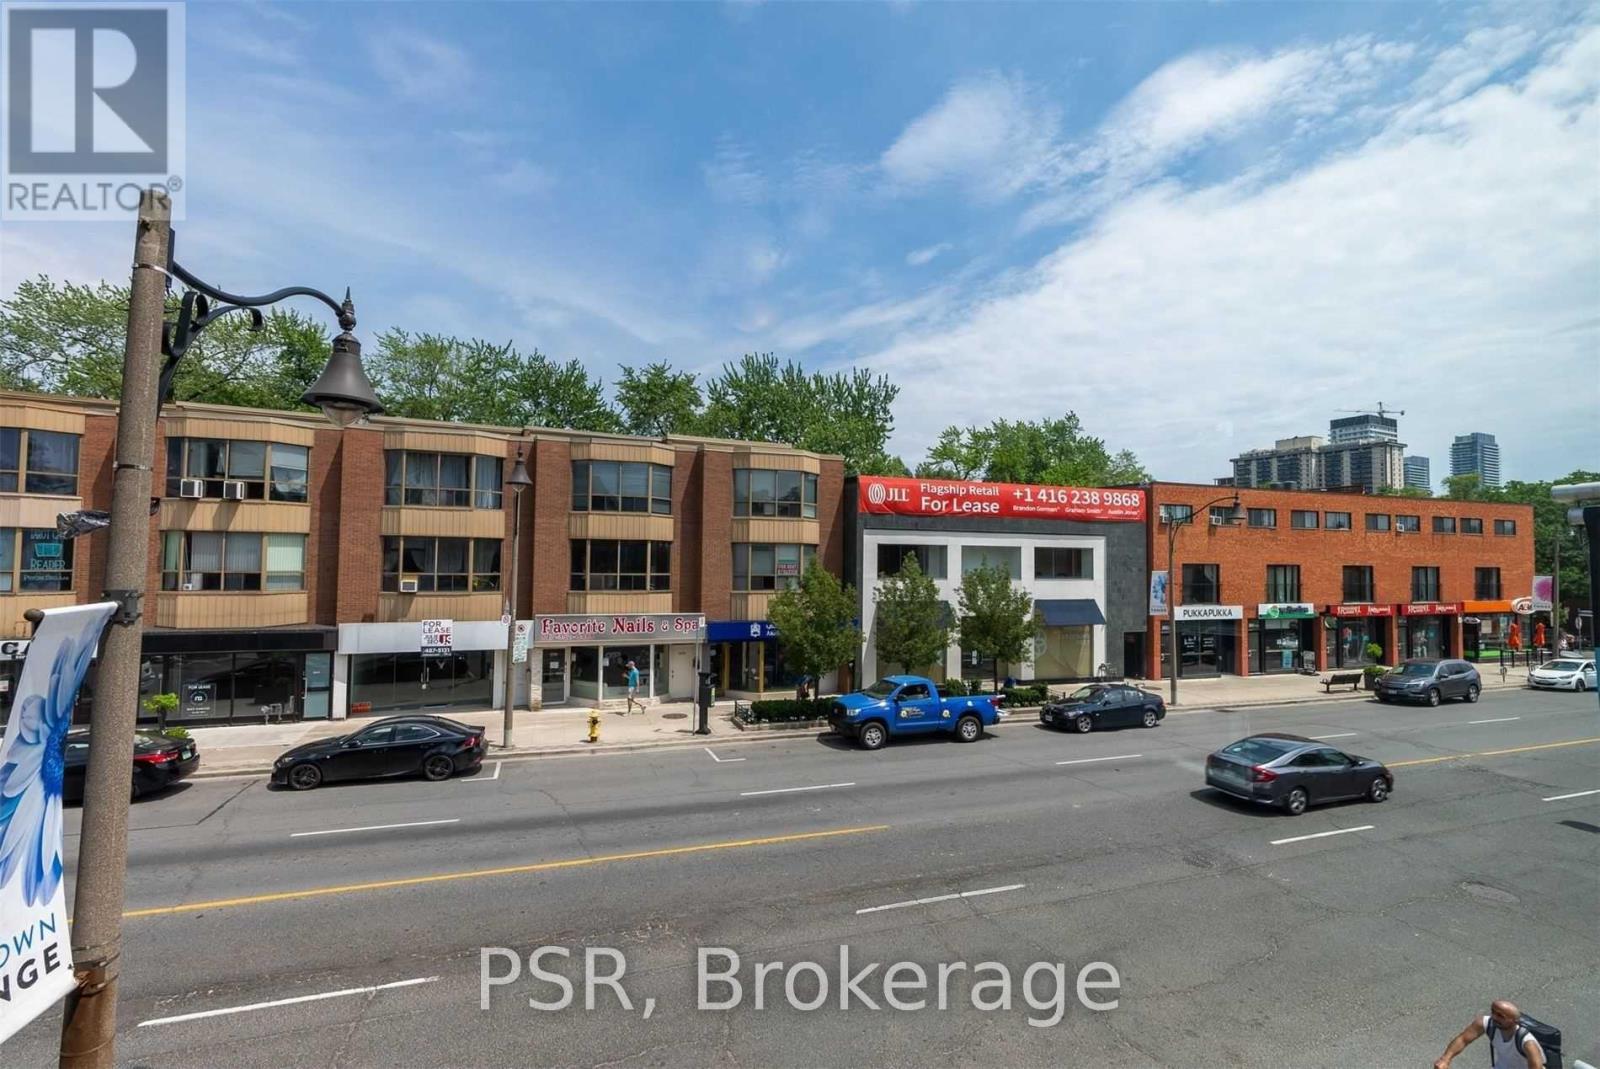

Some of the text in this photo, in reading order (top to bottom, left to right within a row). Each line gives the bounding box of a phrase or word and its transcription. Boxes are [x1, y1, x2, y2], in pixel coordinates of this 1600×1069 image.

[887, 487, 909, 502] JLL
[920, 483, 1000, 496] Flagship Retail
[1013, 488, 1140, 507] +1 416 238 9868
[921, 496, 1000, 513] For Lease
[1183, 609, 1233, 618] PUKKAPUKKA
[541, 617, 605, 634] Favorite
[612, 617, 655, 633] Nails
[674, 617, 700, 633] Spa
